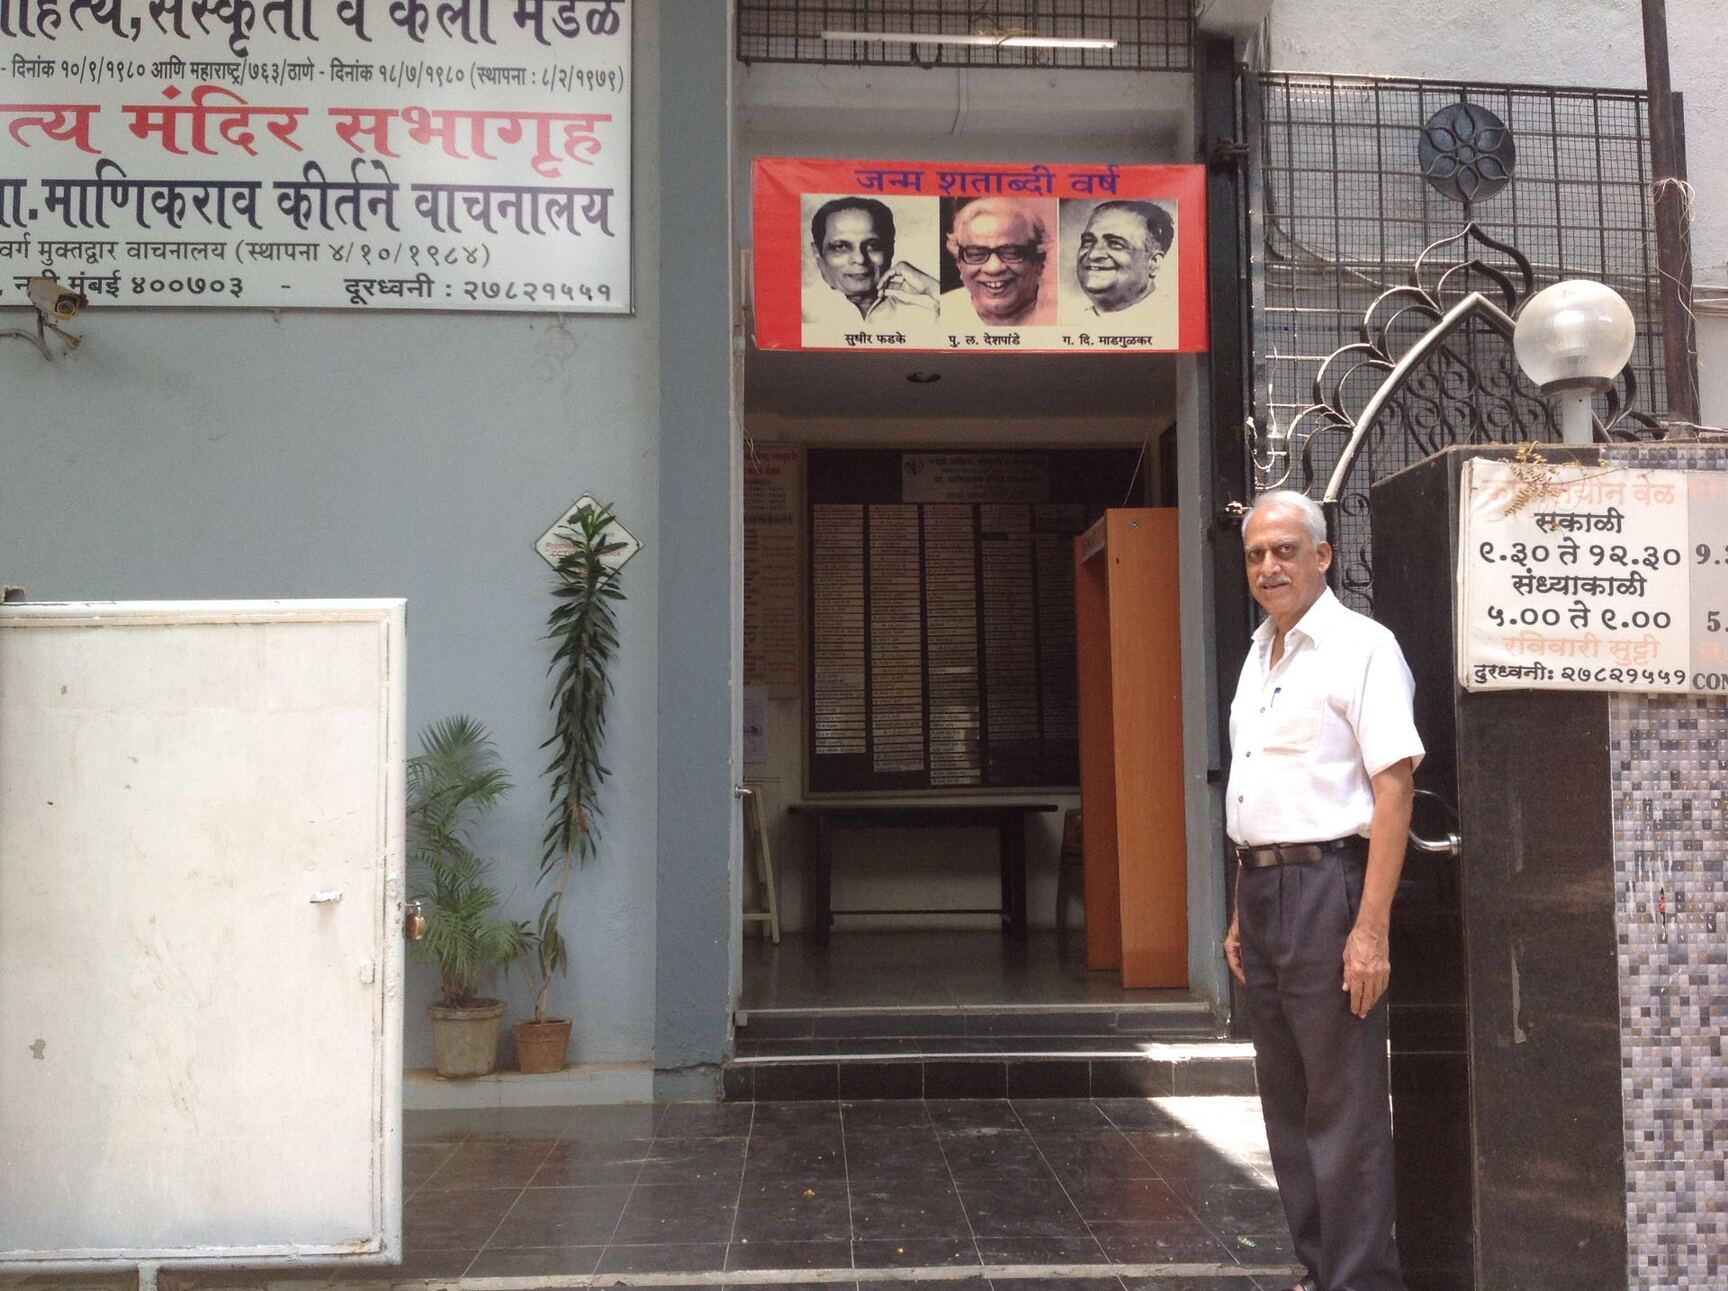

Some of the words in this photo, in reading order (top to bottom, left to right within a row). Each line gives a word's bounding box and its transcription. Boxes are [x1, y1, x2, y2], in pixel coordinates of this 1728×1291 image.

[513, 0, 626, 46] मडळ
[12, 53, 56, 78] दिनांक
[151, 55, 186, 79] आणि
[330, 57, 373, 82] दिनांक
[0, 104, 102, 155] त्य
[121, 84, 308, 156] मंदिर
[327, 106, 612, 177] सभागृह
[855, 169, 925, 193] जन्म
[937, 164, 1057, 196] शताब्दी
[1068, 165, 1121, 194] वर्ष
[273, 158, 400, 231] कीर्तने
[411, 183, 615, 237] वाचनालय
[125, 242, 227, 260] वाचनालय
[236, 240, 320, 264] (स्थापना
[68, 270, 121, 297] मंबई
[132, 277, 243, 298] ४००७०३
[343, 273, 434, 305] दूरध्वनी
[876, 332, 906, 344] फडके
[965, 336, 978, 345] ल.
[984, 333, 1020, 345] देशपांडे
[1063, 336, 1074, 345] ग.
[1534, 506, 1625, 534] सकाळी
[1480, 542, 1549, 567] ९.३०
[1558, 536, 1580, 565] ते
[1589, 545, 1680, 572] १२.३०
[1696, 544, 1728, 565] 9.
[1512, 568, 1647, 597] संध्याकाळी
[1488, 606, 1560, 627] ५.००
[1568, 600, 1591, 629] ते
[1602, 609, 1671, 630] ९.००
